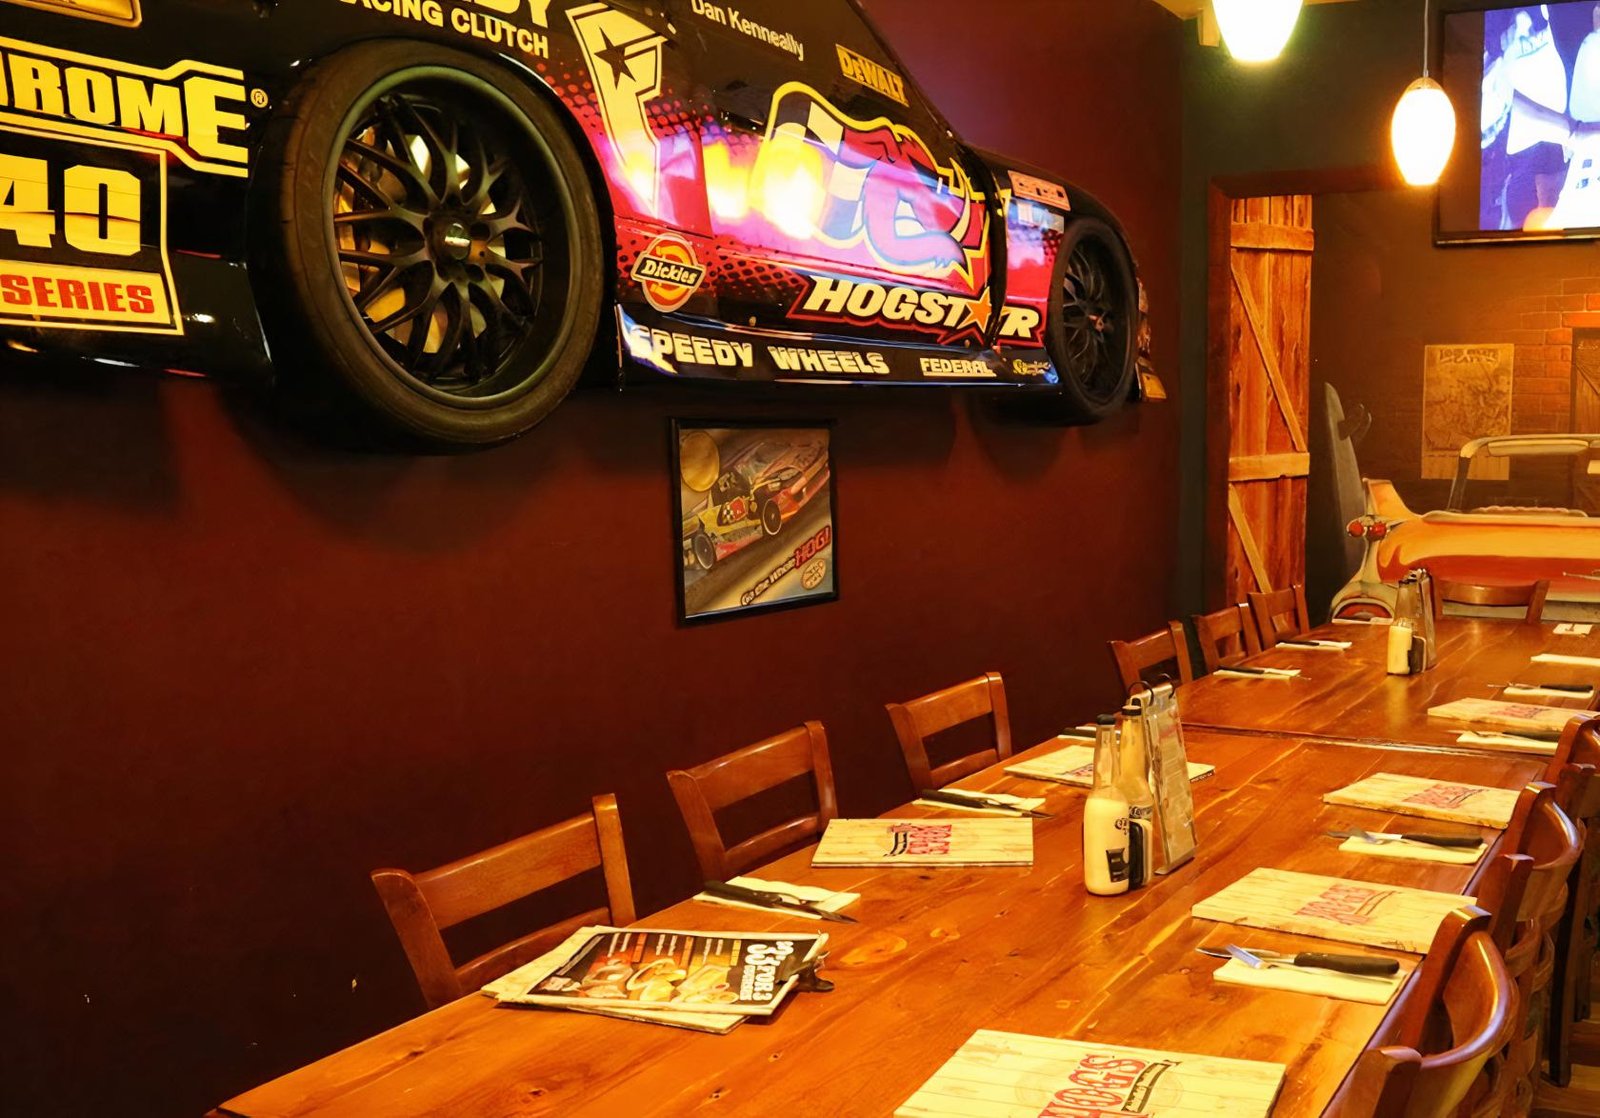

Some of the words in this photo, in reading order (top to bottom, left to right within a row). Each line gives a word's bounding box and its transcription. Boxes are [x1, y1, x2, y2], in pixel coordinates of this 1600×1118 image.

[340, 0, 444, 27] CING
[450, 7, 550, 59] CLUTCH
[691, 0, 727, 25] Dan
[727, 7, 804, 61] Kenneally
[0, 53, 249, 164] ROME
[641, 259, 698, 284] Dickies
[0, 274, 155, 314] SERIES
[766, 345, 890, 375] WHEELS
[919, 357, 994, 375] FEDERAL
